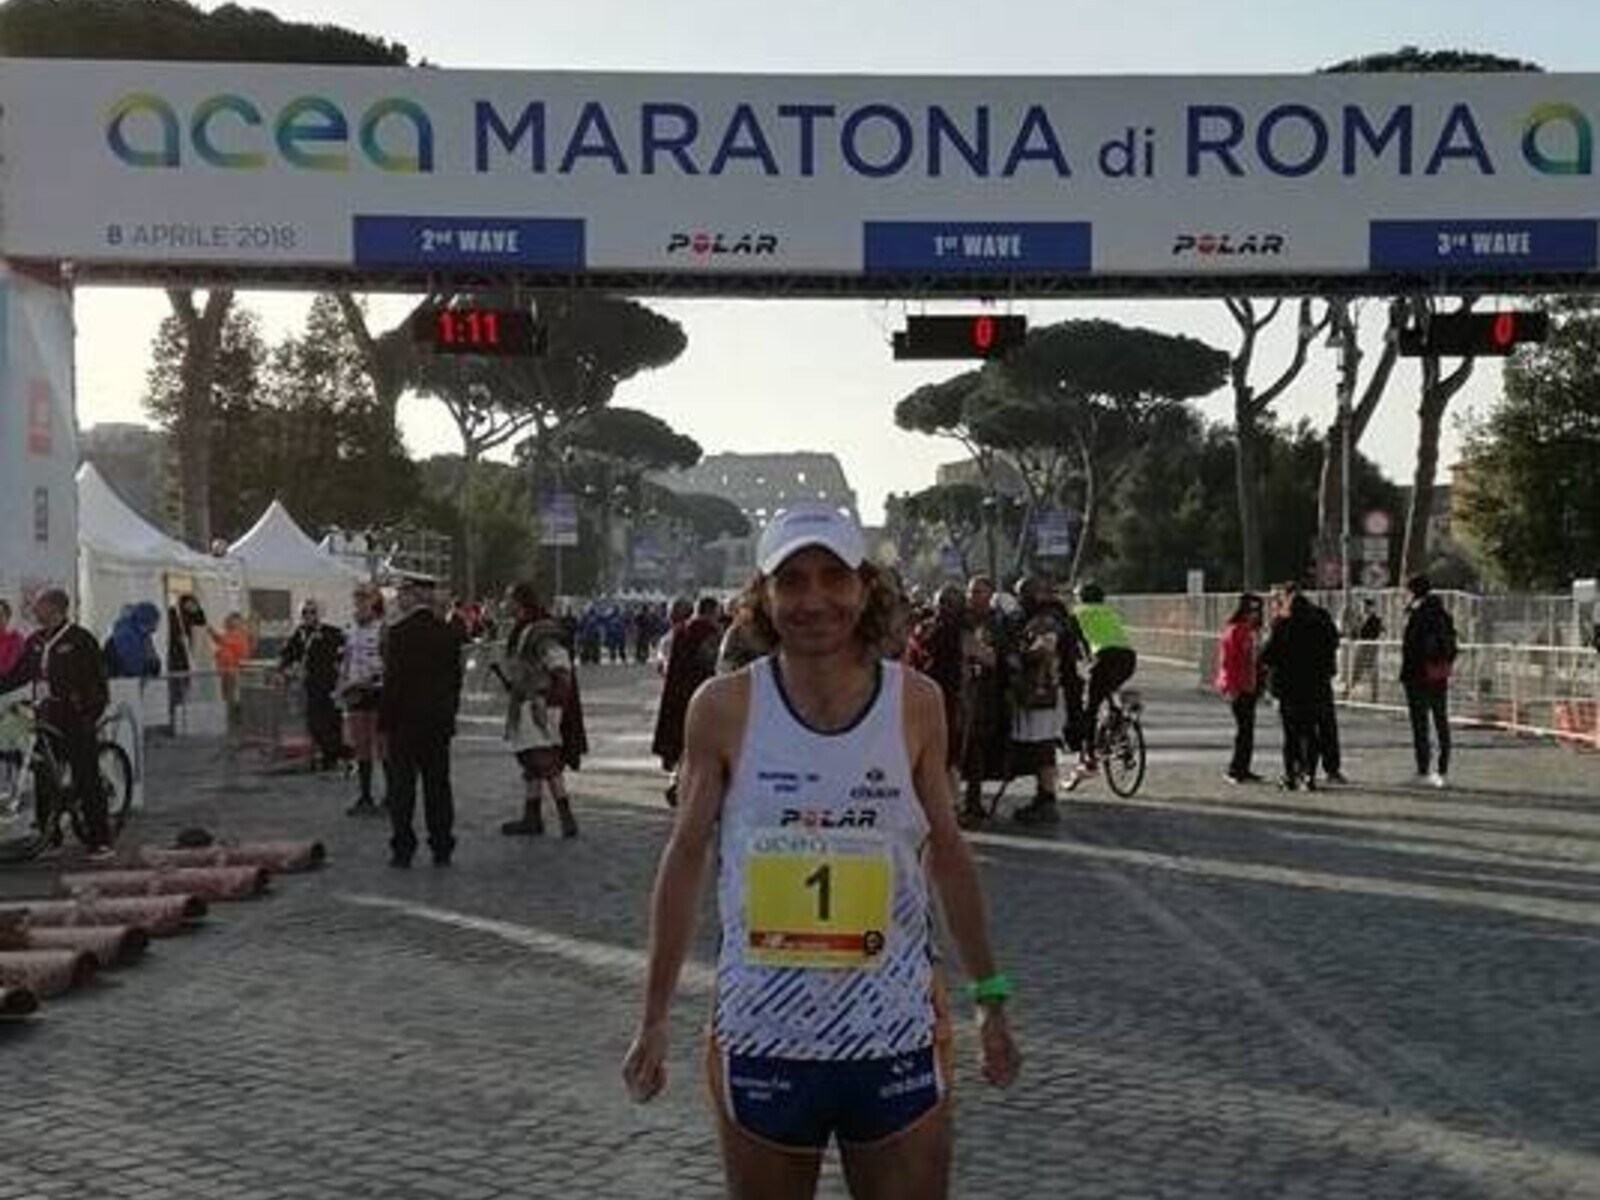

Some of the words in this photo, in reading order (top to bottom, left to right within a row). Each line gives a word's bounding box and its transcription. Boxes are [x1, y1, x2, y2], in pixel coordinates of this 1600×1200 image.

[106, 92, 434, 172] acea
[474, 101, 1071, 178] MARATONA
[1099, 127, 1157, 178] di
[1185, 103, 1496, 177] ROMA
[106, 224, 123, 246] 8
[132, 224, 230, 247] APRILE
[237, 225, 297, 248] 2018
[458, 229, 521, 253] WAVE
[666, 232, 779, 254] POLAR
[962, 234, 1022, 257] WAVE
[1172, 234, 1284, 255] POLAR
[1471, 232, 1531, 254] WAVE
[439, 312, 499, 343] 1:11
[779, 809, 878, 828] POLAR
[804, 863, 831, 922] 1
